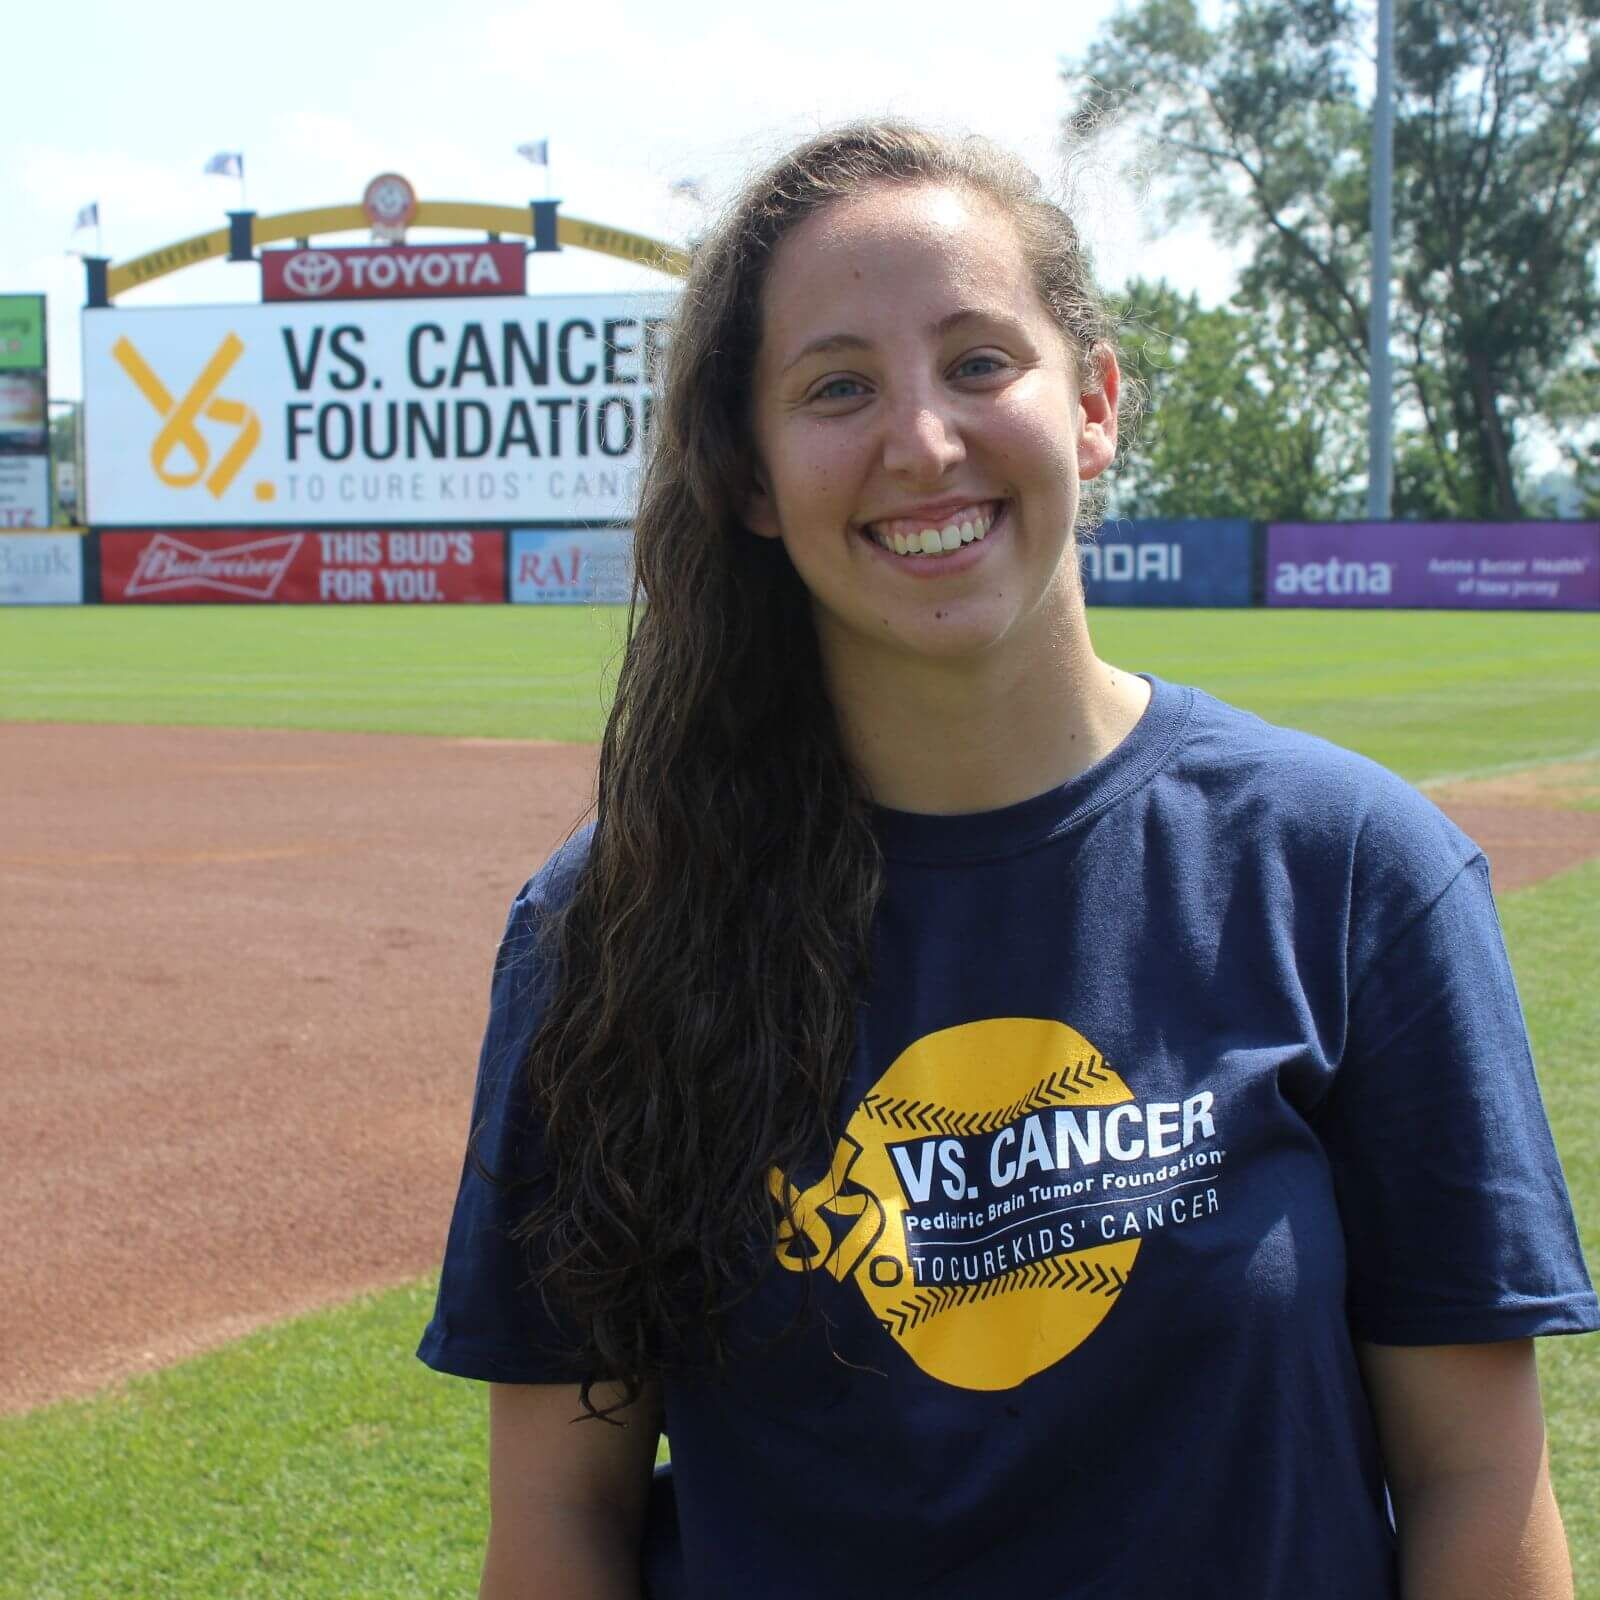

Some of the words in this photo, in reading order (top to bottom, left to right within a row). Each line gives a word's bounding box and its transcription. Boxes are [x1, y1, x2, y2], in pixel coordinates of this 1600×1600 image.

[346, 252, 500, 288] TOYOTA
[282, 326, 382, 391] VS.
[287, 474, 325, 501] TO
[340, 473, 424, 500] CURE
[440, 473, 534, 500] KIDS'
[138, 547, 286, 579] Budweiser
[318, 532, 382, 564] THIS
[387, 532, 474, 564] BUD'S
[319, 570, 373, 600] FOR
[378, 569, 445, 601] YOU.
[1274, 556, 1393, 594] aetna
[892, 1139, 979, 1203] VS.
[990, 1091, 1216, 1188] CANCER
[988, 1194, 1025, 1221] Brain
[1029, 1178, 1095, 1203] Tumor
[1102, 1150, 1223, 1190] Foundation
[912, 1256, 945, 1281] TO
[950, 1245, 1008, 1281] CURE
[1013, 1220, 1086, 1264] KIDS'
[1101, 1188, 1219, 1239] CANCER
